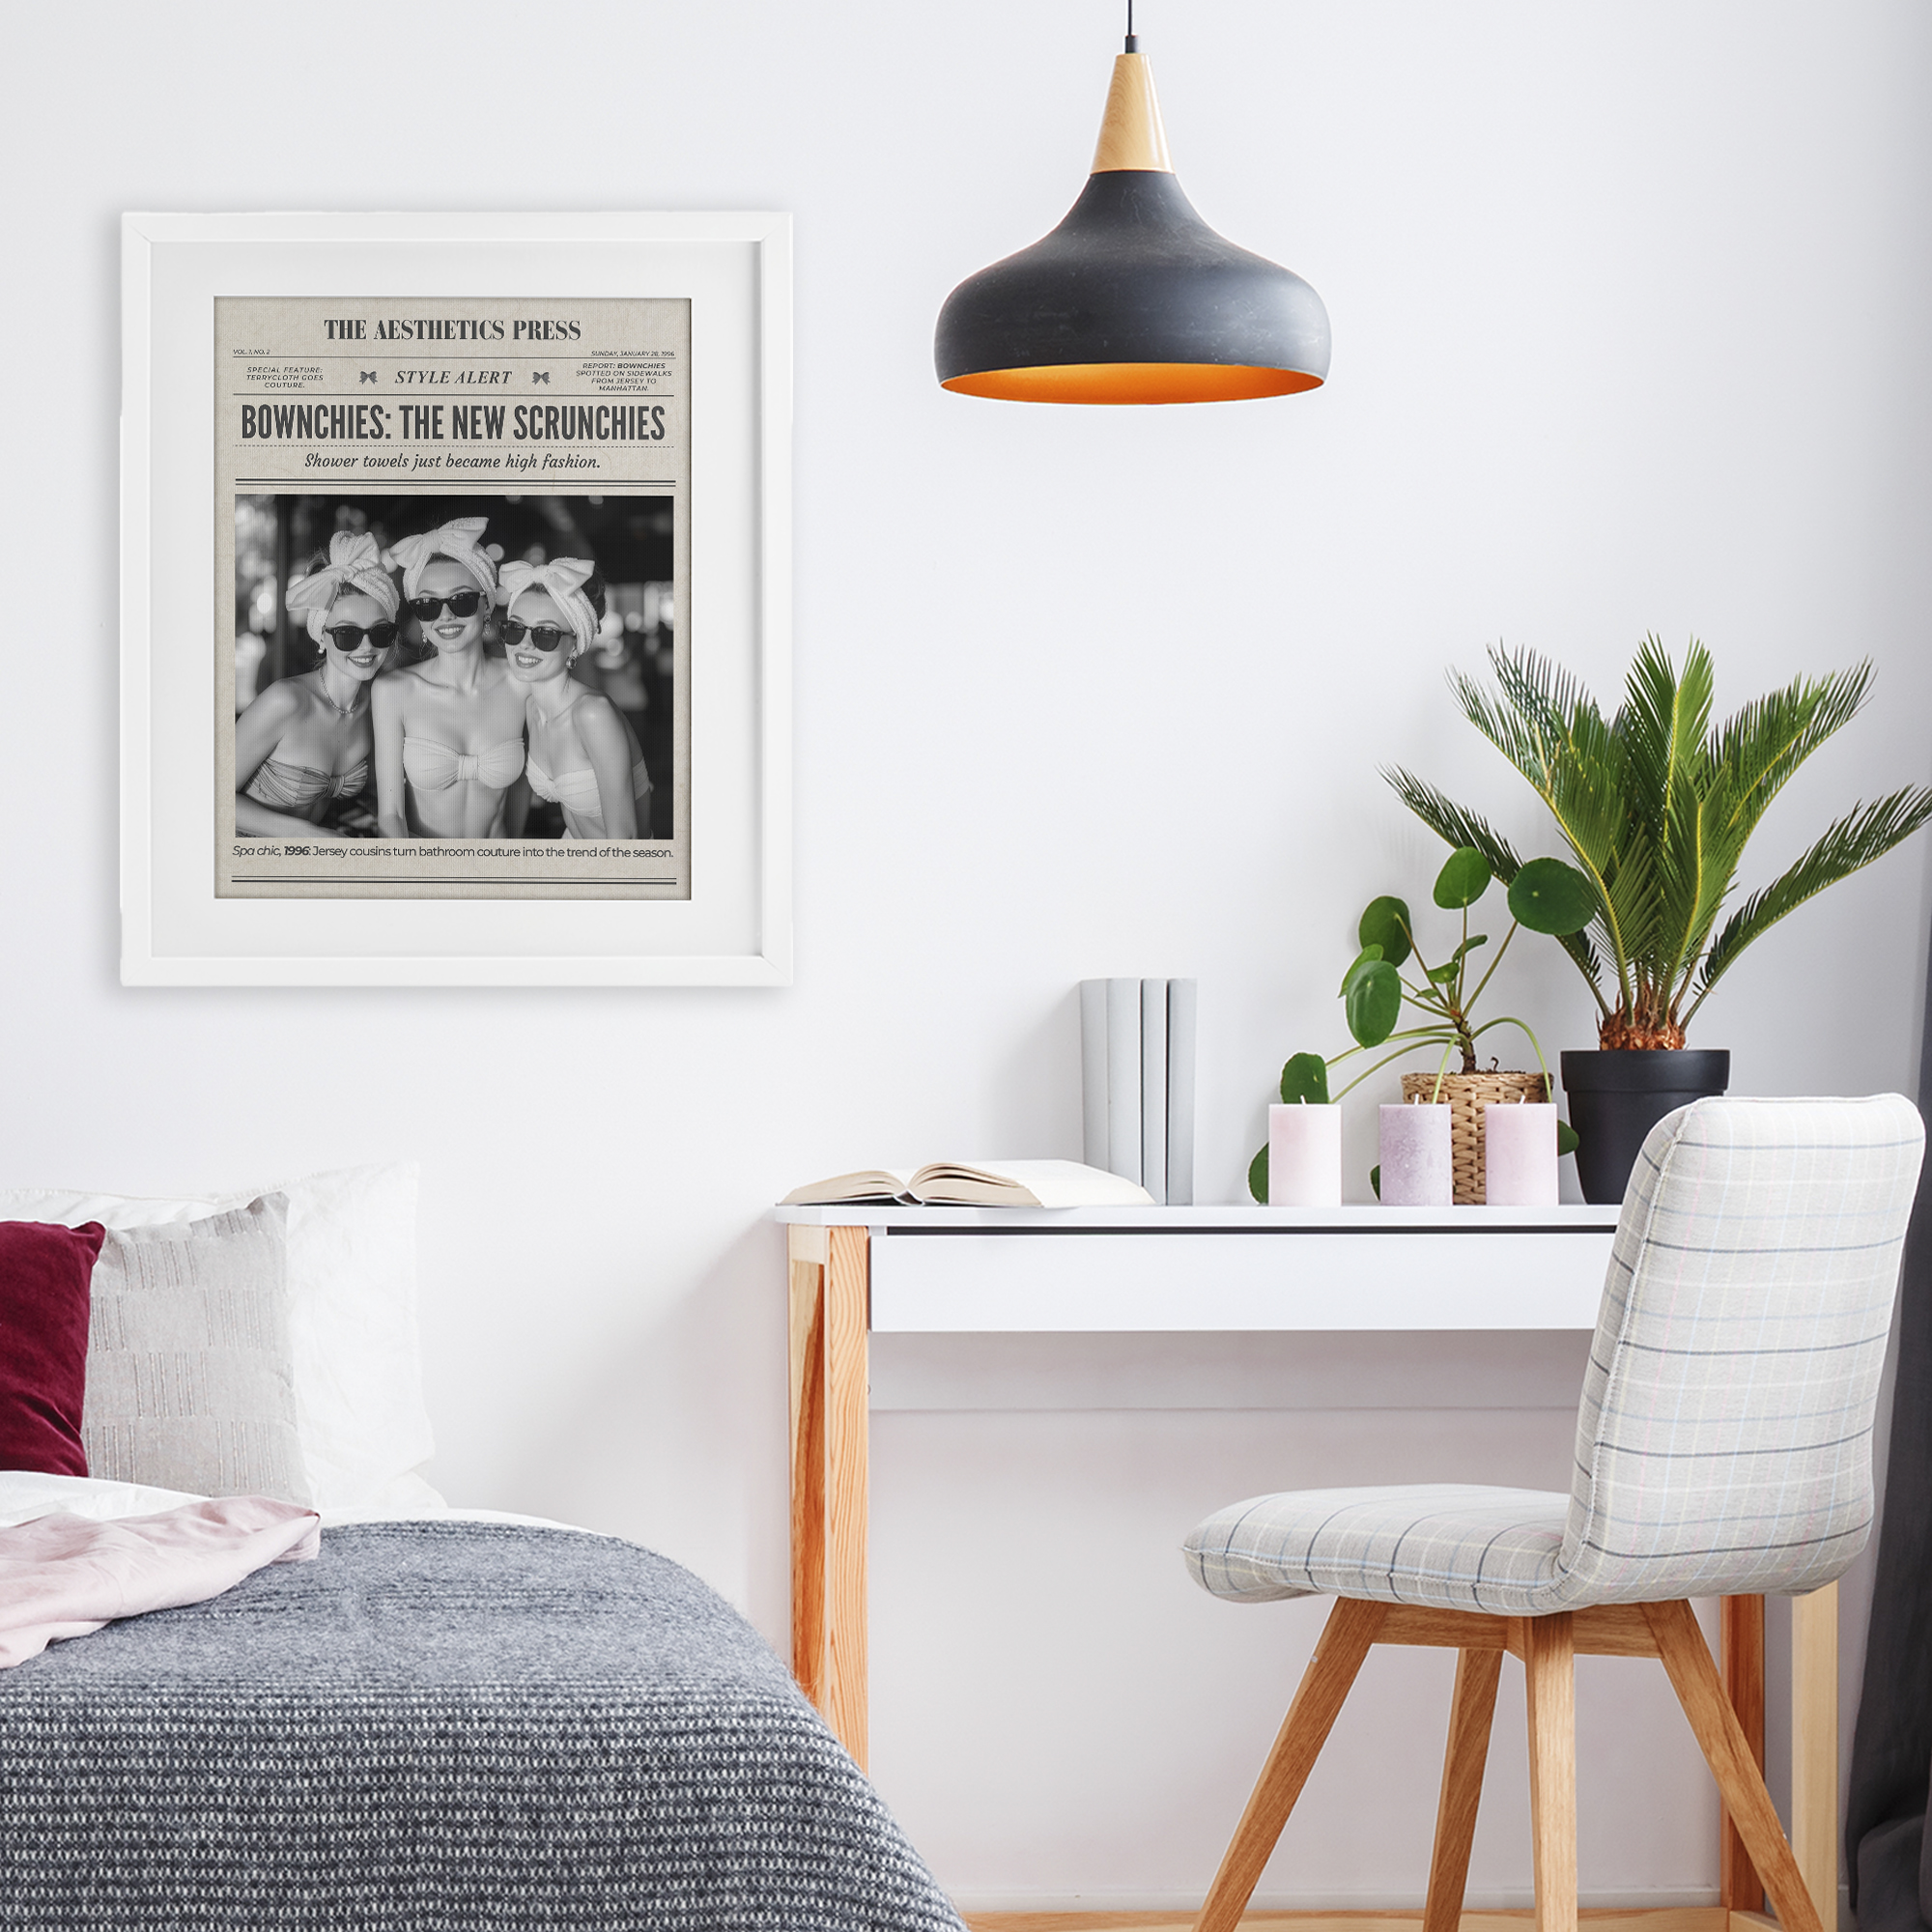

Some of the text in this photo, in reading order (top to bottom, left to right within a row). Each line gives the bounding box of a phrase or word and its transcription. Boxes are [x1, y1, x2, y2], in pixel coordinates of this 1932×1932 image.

[324, 319, 582, 341] THE AESTHETICS PRESS
[394, 370, 513, 384] STYLE ALERT
[242, 404, 666, 441] BOWNCHIES: THE NEW SCRUNCHIES
[304, 452, 601, 473] Shower towels just became high fashion.
[231, 844, 674, 859] Spa chic, 1996: Jersey cousins turn bathroom couture into the trend of the season.
